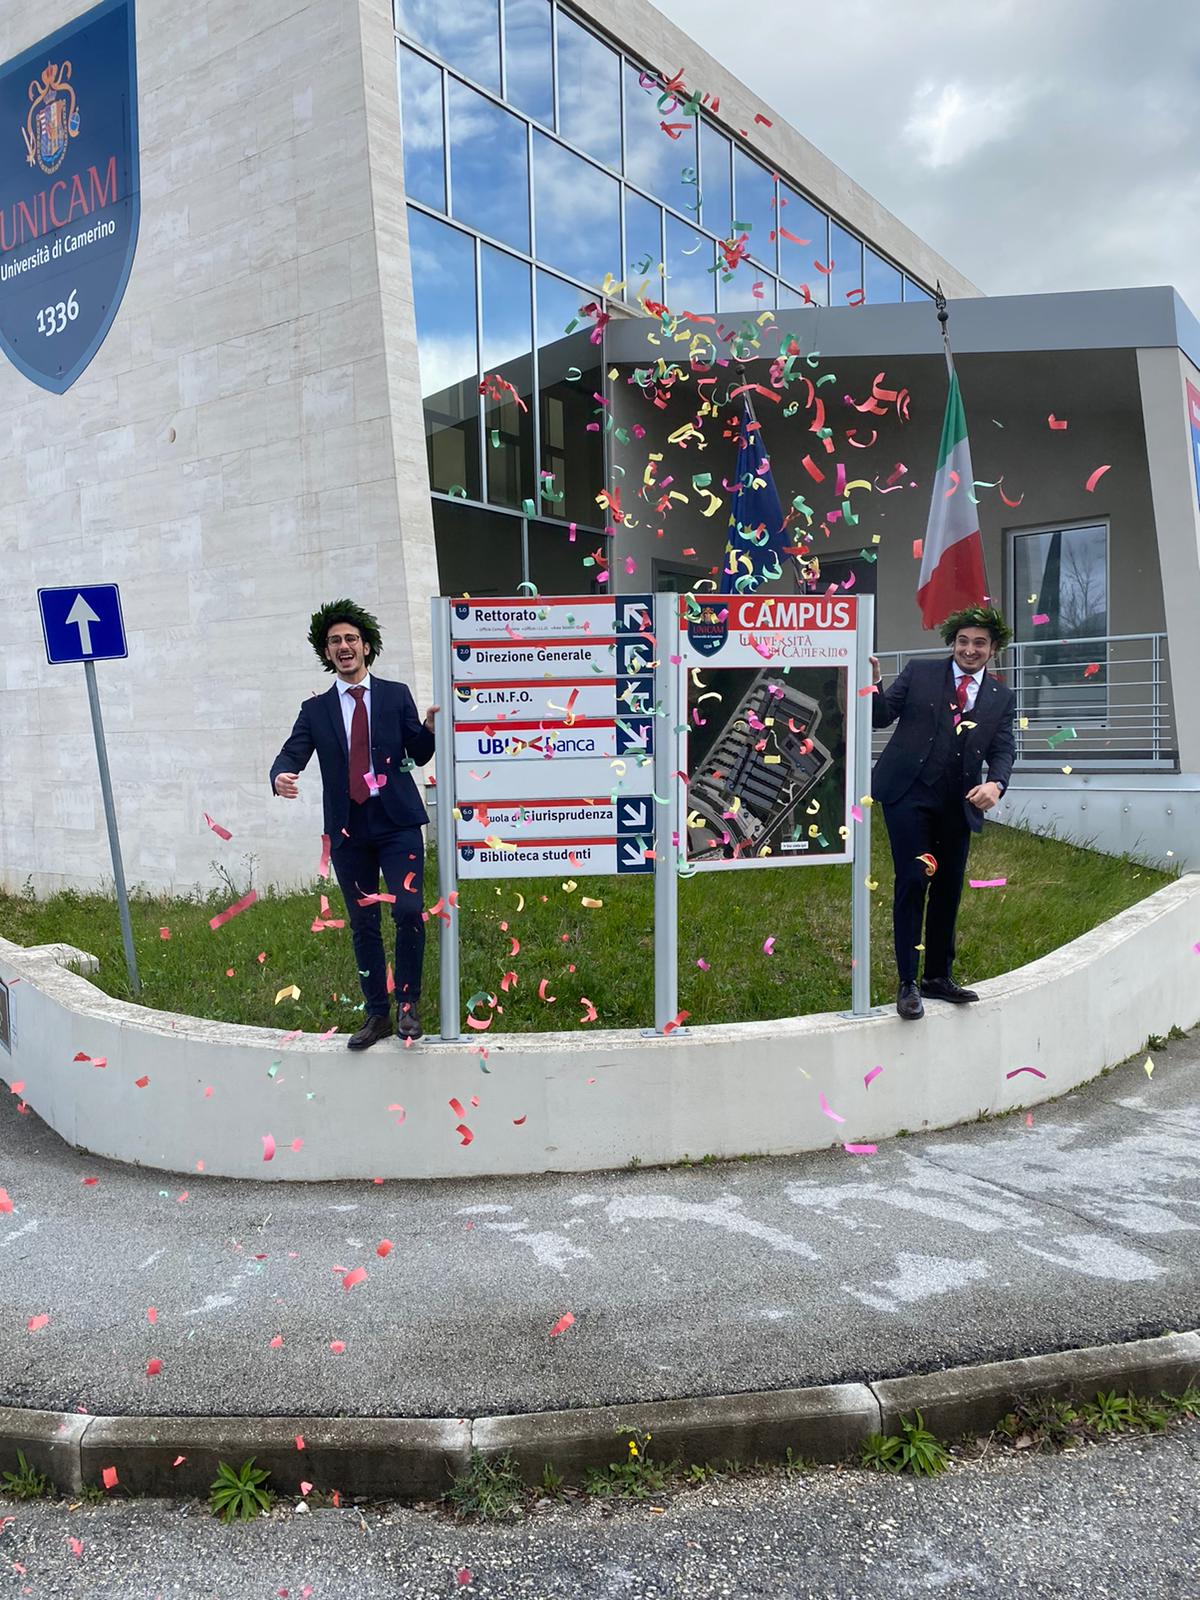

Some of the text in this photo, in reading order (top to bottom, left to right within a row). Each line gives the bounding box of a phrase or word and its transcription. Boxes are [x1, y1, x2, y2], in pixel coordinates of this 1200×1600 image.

[0, 156, 118, 251] UNICAM
[1, 220, 115, 281] Università di Camerino
[36, 288, 79, 337] 1336
[475, 608, 536, 622] Rettorato
[738, 602, 849, 628] CAMPUS
[476, 650, 533, 663] Direzione
[537, 649, 591, 661] Generale
[476, 690, 533, 704] C.I.N.F.O.
[523, 810, 613, 823] Giurisprudenza
[480, 851, 539, 862] Biblioteca
